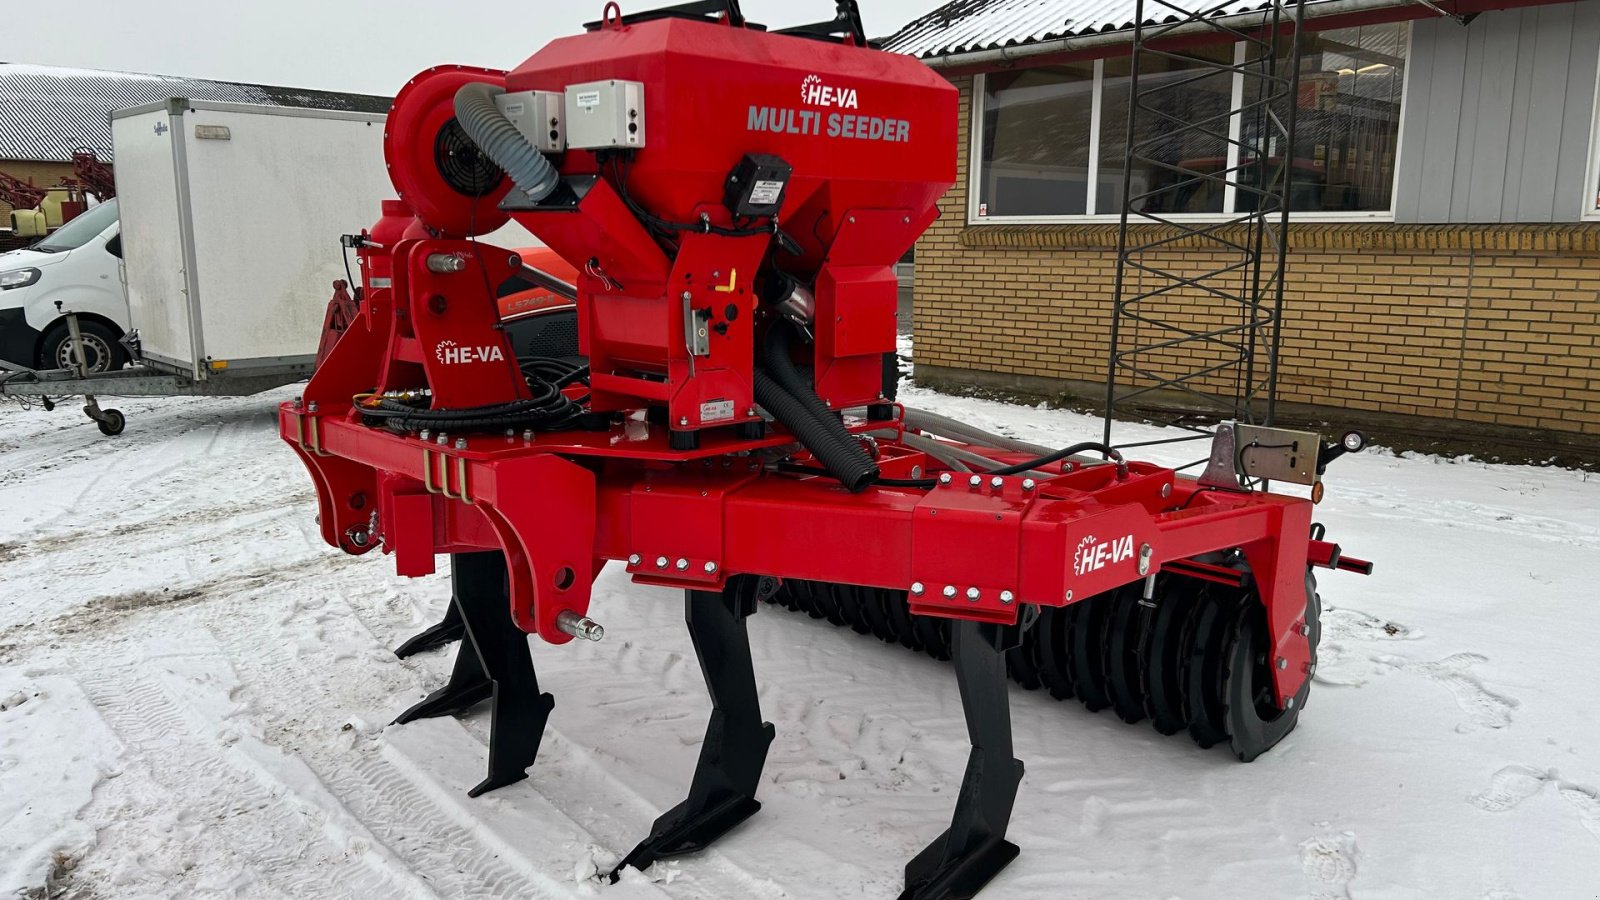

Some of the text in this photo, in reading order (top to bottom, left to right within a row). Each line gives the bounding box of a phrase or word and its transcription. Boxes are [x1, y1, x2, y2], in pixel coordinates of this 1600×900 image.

[807, 84, 858, 109] HE-VA
[747, 105, 910, 143] MULTI SEEDER
[445, 345, 505, 365] HE-VA
[1080, 534, 1134, 576] HE-VA
